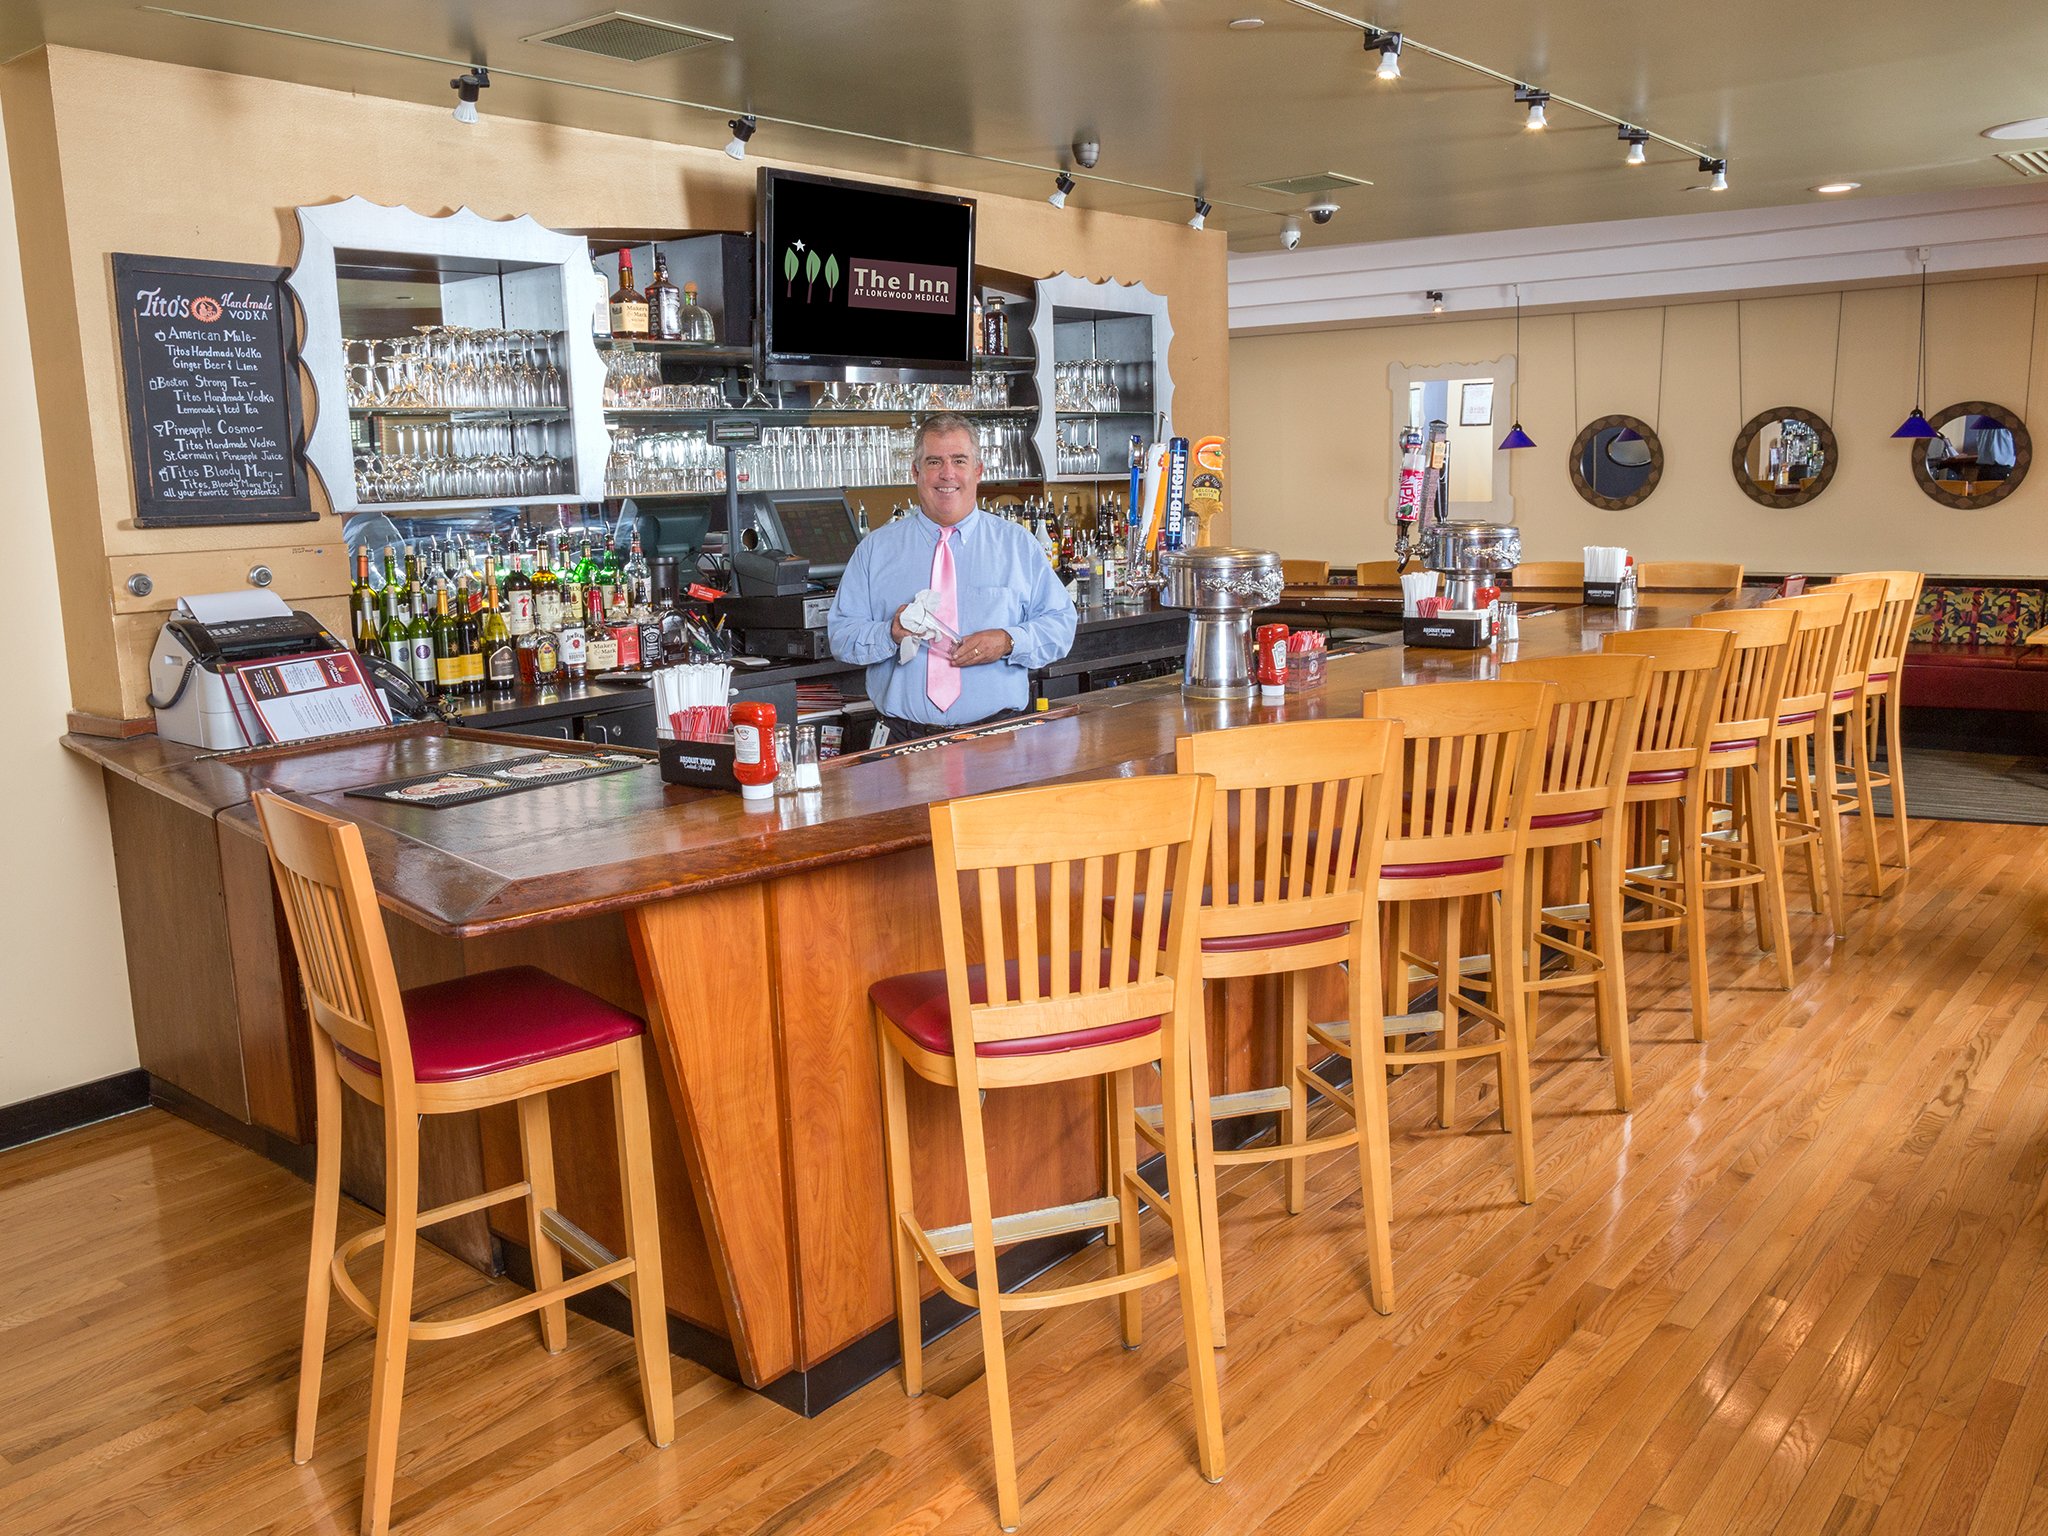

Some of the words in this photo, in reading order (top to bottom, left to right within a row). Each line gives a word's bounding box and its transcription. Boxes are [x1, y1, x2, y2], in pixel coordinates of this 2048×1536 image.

[854, 268, 900, 290] The
[908, 273, 949, 294] Inn
[137, 287, 190, 318] Tito's
[220, 292, 272, 310] Handmade
[866, 290, 912, 300] LONGWOOD
[915, 294, 949, 303] MEDICAL
[228, 310, 268, 321] VODKA
[168, 326, 221, 341] American
[192, 346, 234, 358] Handmade
[172, 357, 201, 372] Ginger
[204, 358, 224, 370] Beer
[236, 361, 258, 371] Lime
[156, 376, 189, 389] Boston
[195, 374, 228, 391] Strong
[204, 390, 245, 402] Handmade
[247, 390, 274, 402] Vodka
[176, 404, 216, 414] Lemonade
[224, 403, 240, 414] Iced
[244, 403, 258, 414] Tea
[164, 419, 212, 438] Pineapple
[206, 438, 248, 450] Handmade
[250, 437, 276, 448] Vodka
[222, 451, 258, 463] Pineapple
[261, 450, 284, 460] Juice
[202, 463, 242, 482] Bloody
[1170, 454, 1185, 498] LIGHT
[212, 479, 239, 490] Bloody
[240, 480, 262, 491] Mary
[263, 479, 276, 489] Mix
[164, 488, 176, 498] all
[177, 490, 194, 500] your
[198, 489, 230, 498] favorite
[232, 488, 280, 498] ingredients!
[1169, 500, 1182, 532] BUD
[518, 596, 530, 617] 7
[680, 756, 698, 764] ABSOLUT
[700, 758, 716, 766] VODKA
